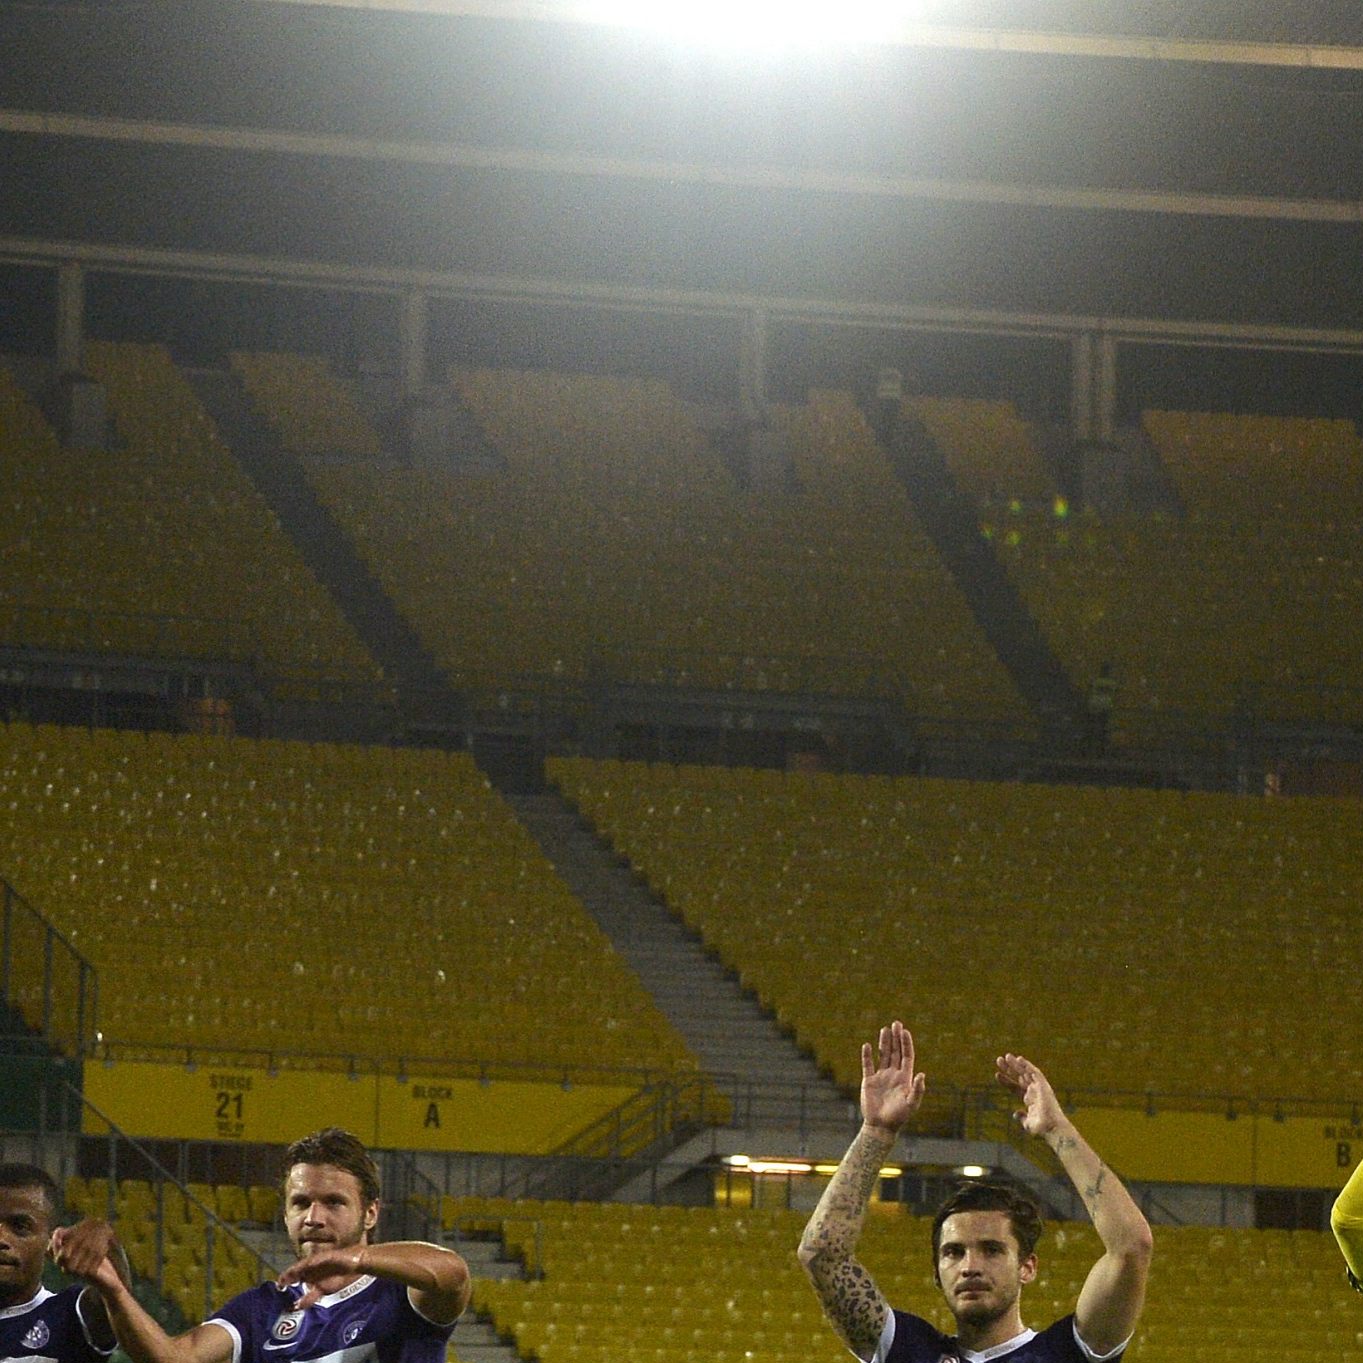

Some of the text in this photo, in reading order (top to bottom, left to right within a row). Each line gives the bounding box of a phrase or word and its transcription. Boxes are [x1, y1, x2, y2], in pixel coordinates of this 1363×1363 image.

[215, 1092, 243, 1119] 21
[423, 1102, 441, 1129] A
[1336, 1142, 1352, 1167] B
